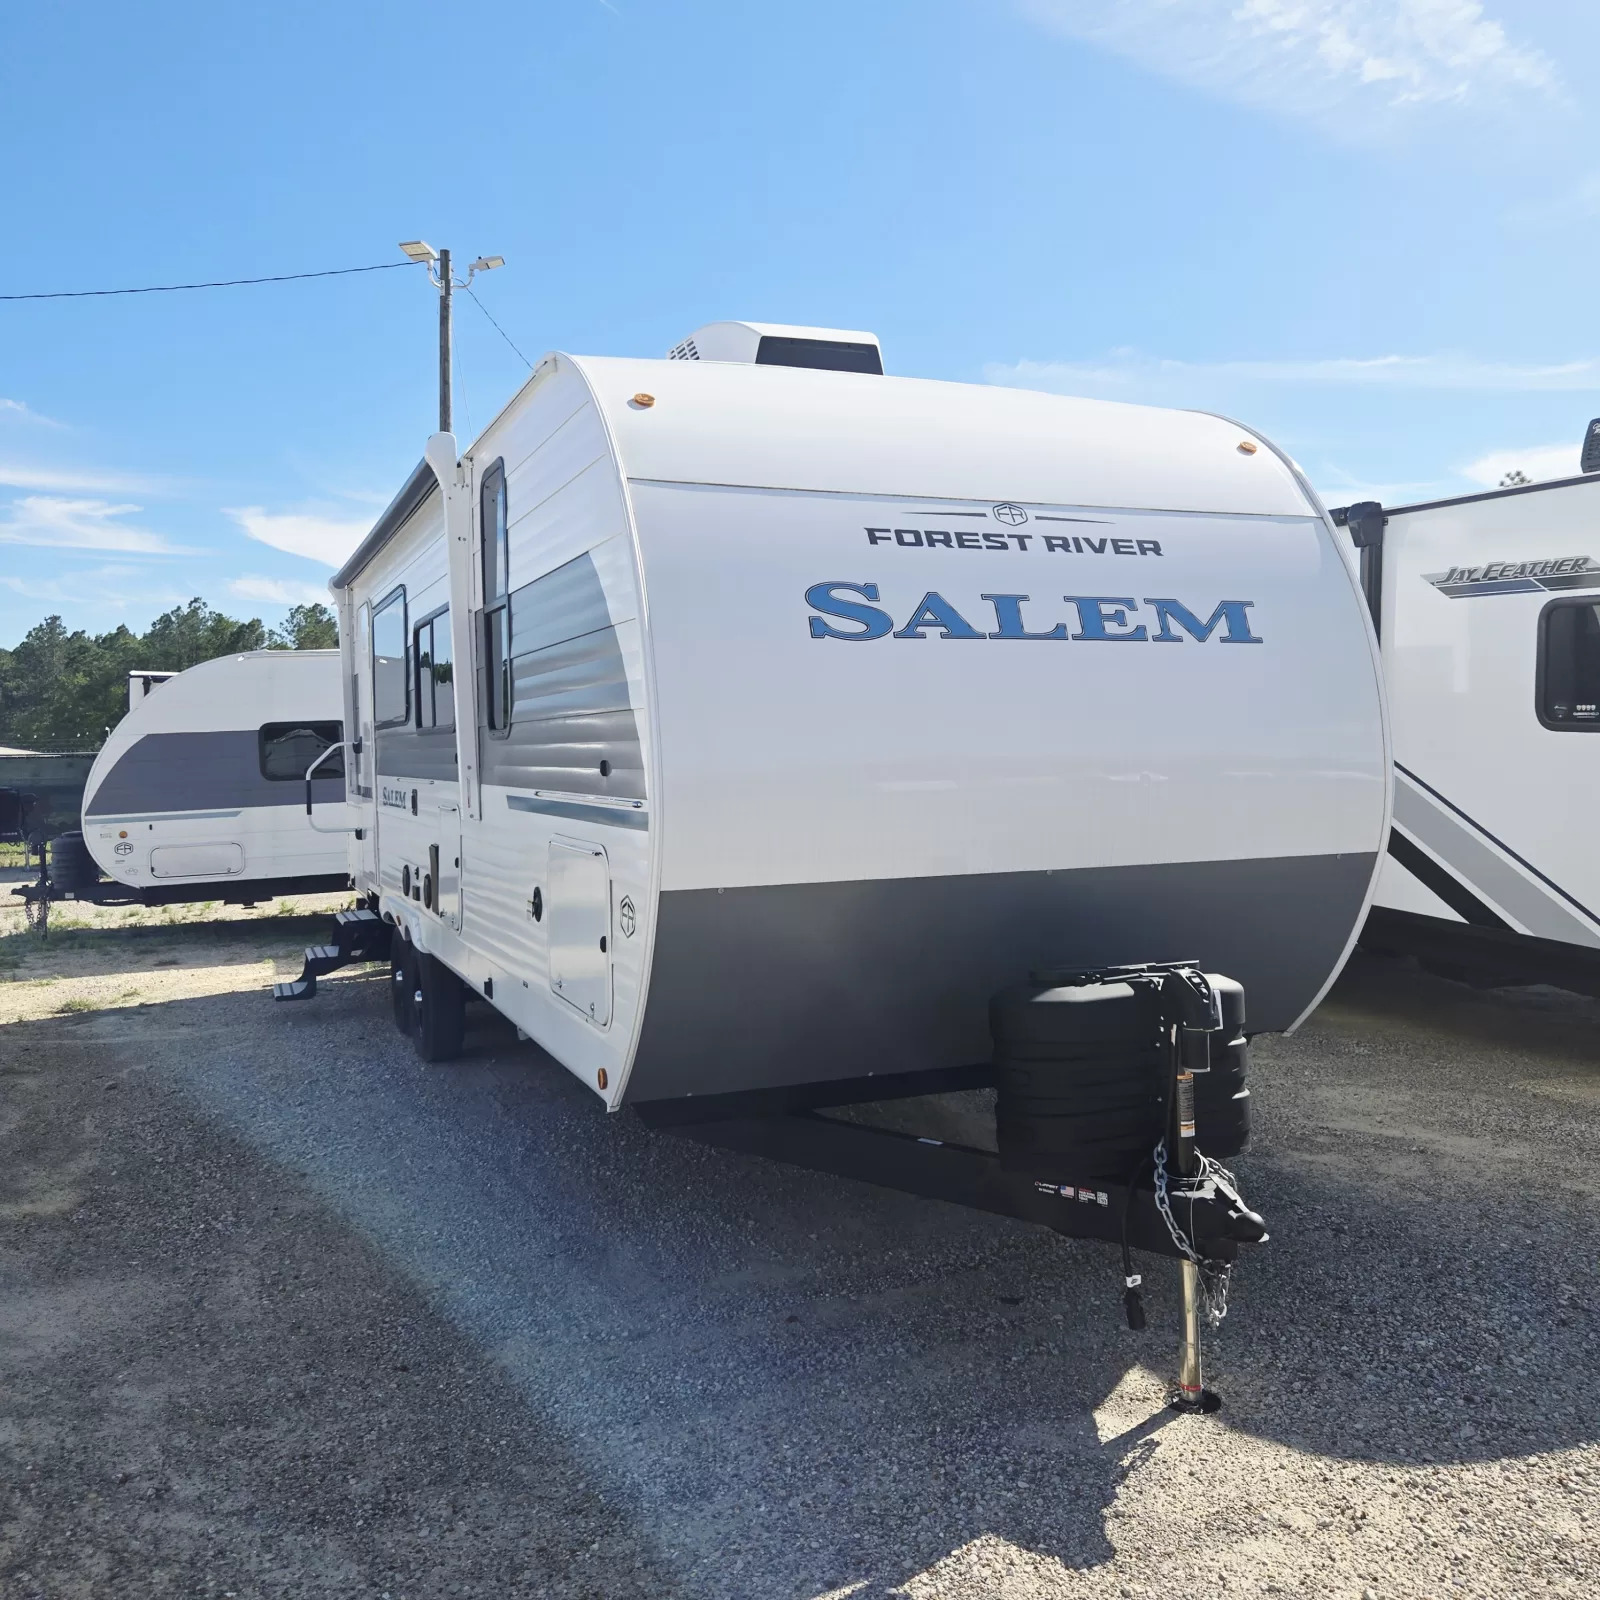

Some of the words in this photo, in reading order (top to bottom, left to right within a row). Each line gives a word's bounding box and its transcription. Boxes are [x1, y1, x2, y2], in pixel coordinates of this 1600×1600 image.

[863, 527, 1033, 552] FOREST
[1041, 535, 1164, 557] RIVER
[1434, 566, 1479, 586] JAY
[1480, 555, 1590, 581] FEATHER
[804, 580, 1264, 644] SALEM
[382, 786, 407, 810] SALEM
